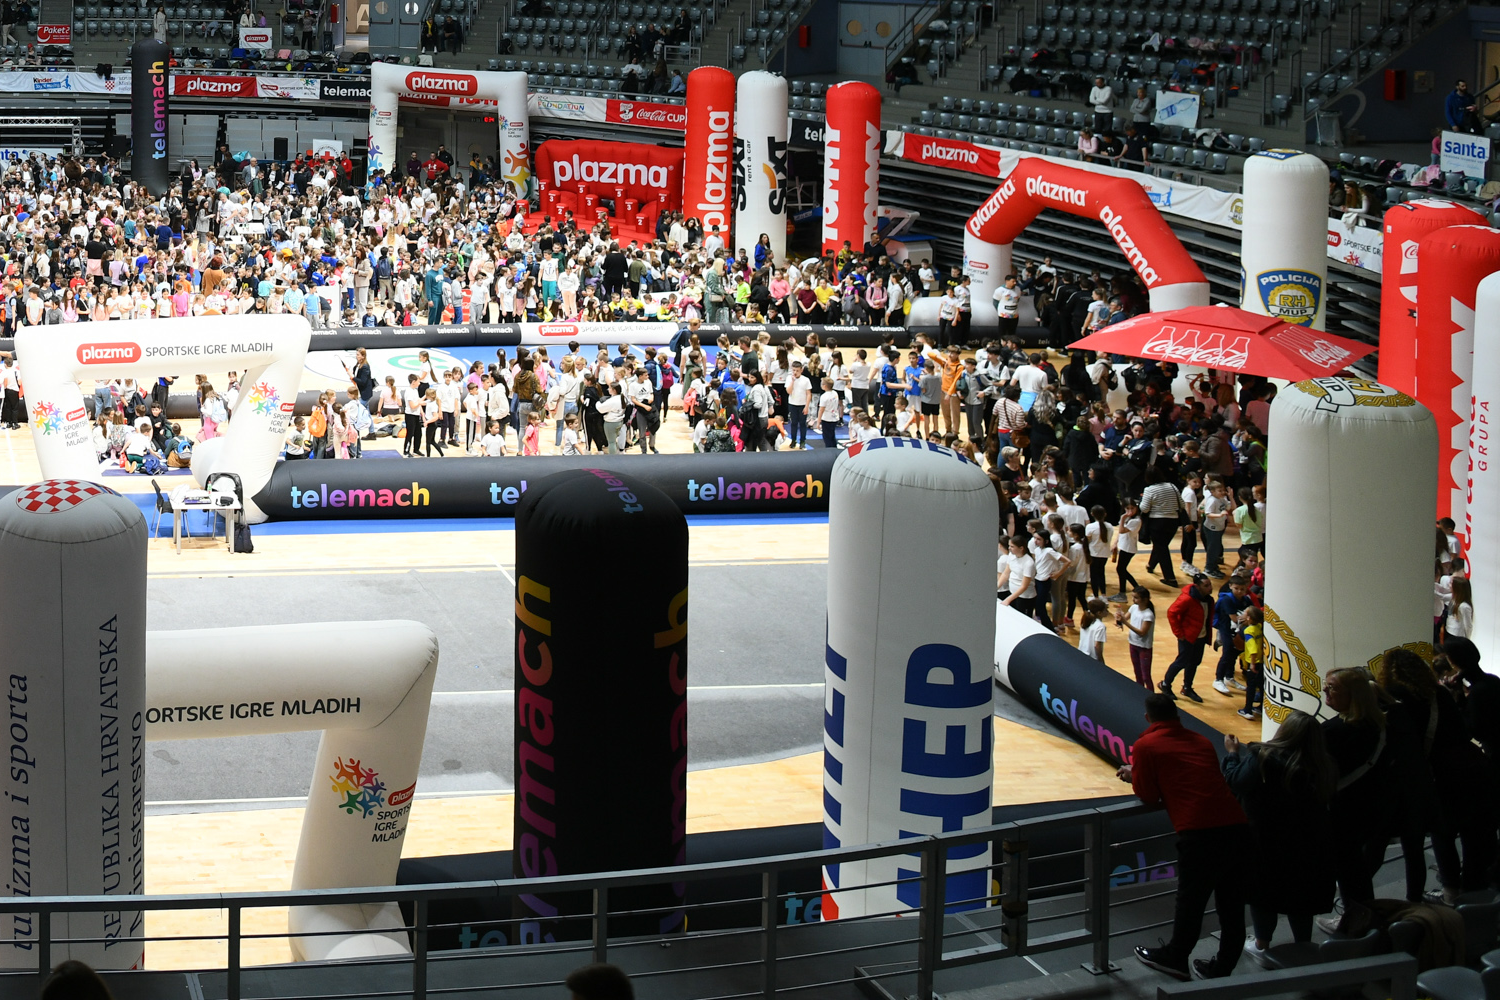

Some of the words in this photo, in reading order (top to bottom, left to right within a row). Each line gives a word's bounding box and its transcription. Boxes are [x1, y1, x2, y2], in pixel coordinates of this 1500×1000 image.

[186, 77, 242, 93] plazma
[323, 86, 371, 97] telemac
[412, 74, 470, 92] plazma
[148, 61, 166, 159] telemach
[667, 114, 685, 123] CUP
[921, 142, 979, 164] plazma
[1444, 140, 1487, 160] santa
[553, 153, 668, 188] plazma
[697, 111, 730, 232] plazma
[1025, 175, 1087, 207] plazma
[969, 176, 1017, 237] plazma
[1099, 205, 1159, 286] plazma
[1260, 273, 1320, 288] POLICIJA
[1279, 294, 1306, 307] RH
[1279, 306, 1308, 316] MUP
[349, 327, 382, 335] telemach
[393, 327, 426, 335] telemach
[436, 326, 470, 335] telemach
[480, 326, 514, 334] telemach
[541, 325, 575, 335] plazma
[82, 346, 134, 363] plazma
[146, 345, 201, 357] SPORTSKE
[202, 344, 228, 355] IGRE
[231, 342, 274, 354] MLADIH
[67, 408, 85, 420] plazma
[65, 432, 79, 440] IGRE
[66, 435, 89, 447] MLADIH
[1478, 400, 1490, 471] GRUPA
[290, 481, 431, 510] telemach
[687, 474, 823, 502] telemach
[99, 613, 120, 778] HRVATSKA
[145, 704, 224, 723] ORTSKE
[229, 701, 275, 720] IGRE
[281, 697, 361, 717] MLADIH
[4, 674, 36, 783] sporta
[374, 821, 397, 832] IGRE
[101, 779, 123, 952] REUBLIKA
[5, 816, 33, 951] tuizma
